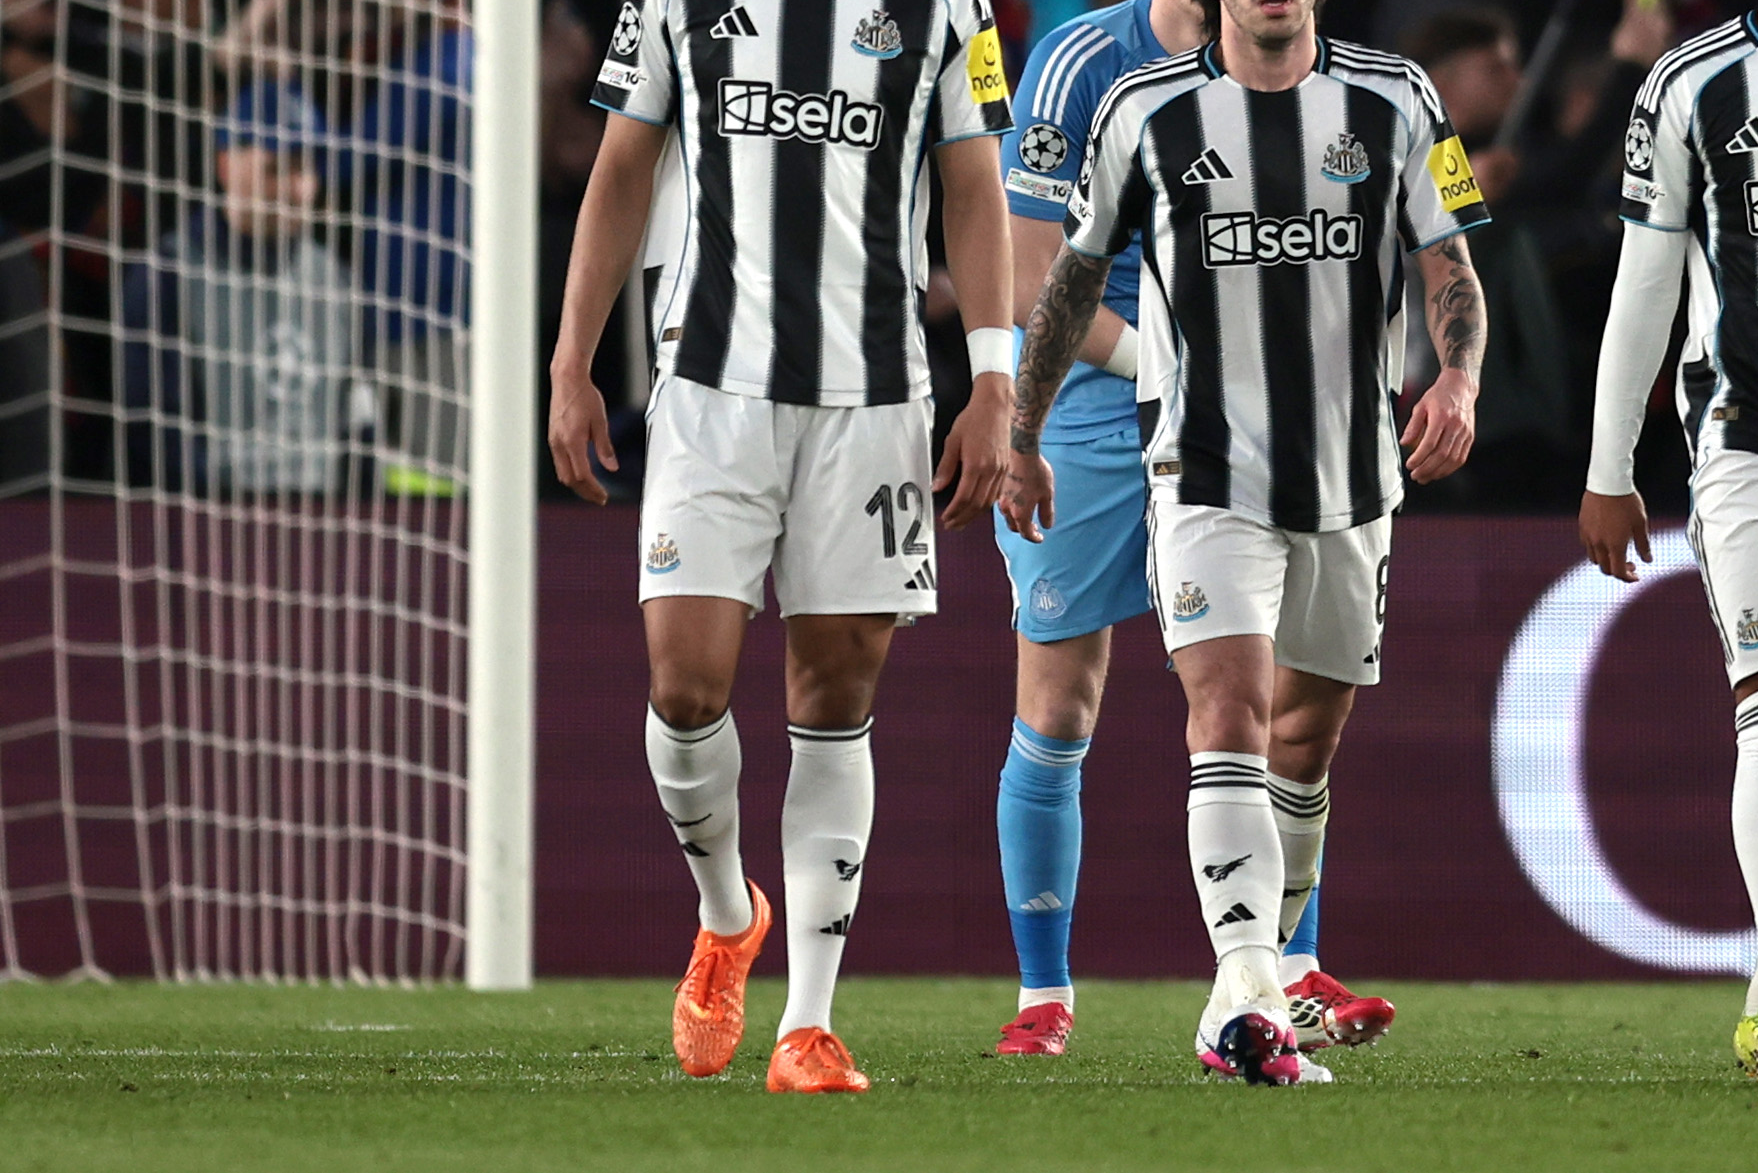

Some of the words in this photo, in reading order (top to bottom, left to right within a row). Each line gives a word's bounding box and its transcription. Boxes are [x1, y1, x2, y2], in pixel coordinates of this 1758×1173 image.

[972, 72, 1004, 91] noo
[769, 93, 877, 145] sela
[1256, 212, 1359, 260] sela
[864, 481, 928, 559] 12
